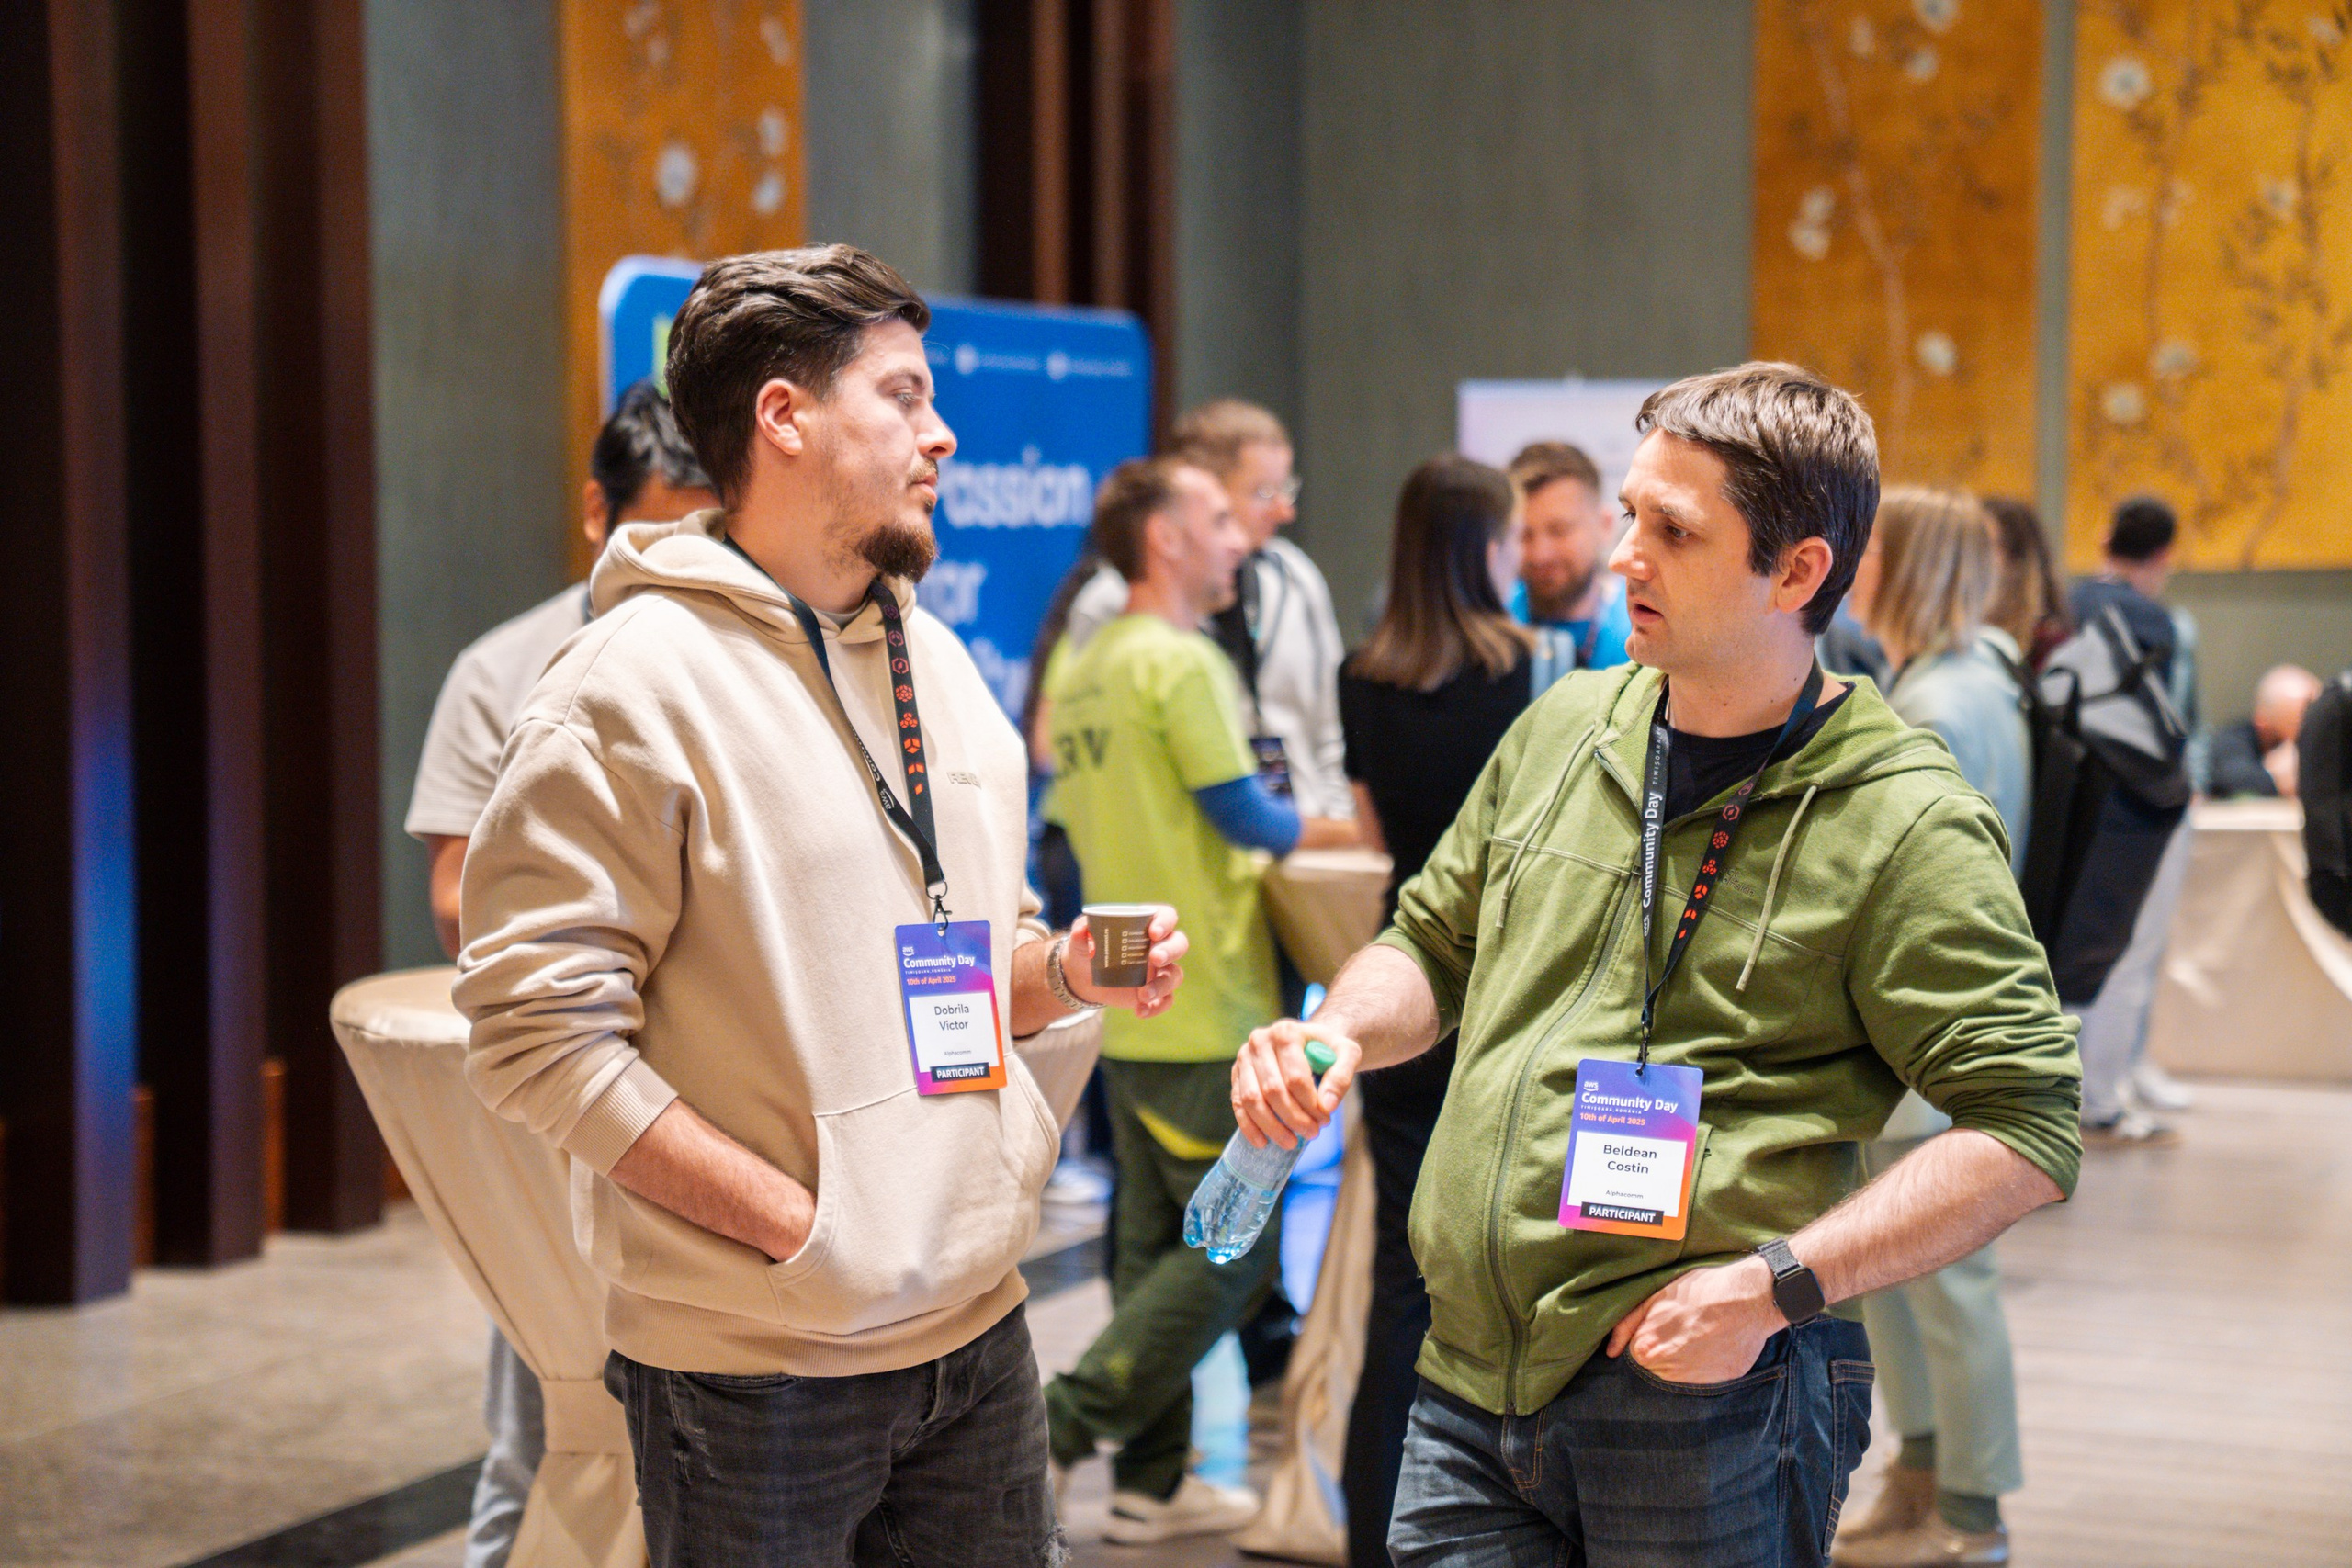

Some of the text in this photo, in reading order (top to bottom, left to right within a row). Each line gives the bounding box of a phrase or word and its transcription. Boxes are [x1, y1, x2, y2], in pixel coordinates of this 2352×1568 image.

[1645, 792, 1663, 819] Day
[1643, 822, 1659, 908] Community
[903, 955, 976, 969] Community Day
[906, 977, 920, 986] 10th
[928, 976, 942, 985] April
[942, 976, 956, 984] 2025
[933, 1004, 970, 1016] Dobrila
[939, 1021, 969, 1031] Victor
[936, 1066, 986, 1079] PARTICIPANT
[1583, 1080, 1599, 1090] aws
[1581, 1092, 1679, 1114] Community Day
[1579, 1112, 1597, 1122] 10th
[1607, 1114, 1626, 1124] April
[1627, 1117, 1646, 1126] 2025
[1603, 1144, 1657, 1159] Beldean
[1607, 1160, 1649, 1174] Costin
[1605, 1190, 1644, 1200] Alphacomm
[1589, 1205, 1657, 1223] PARTICIPANT
